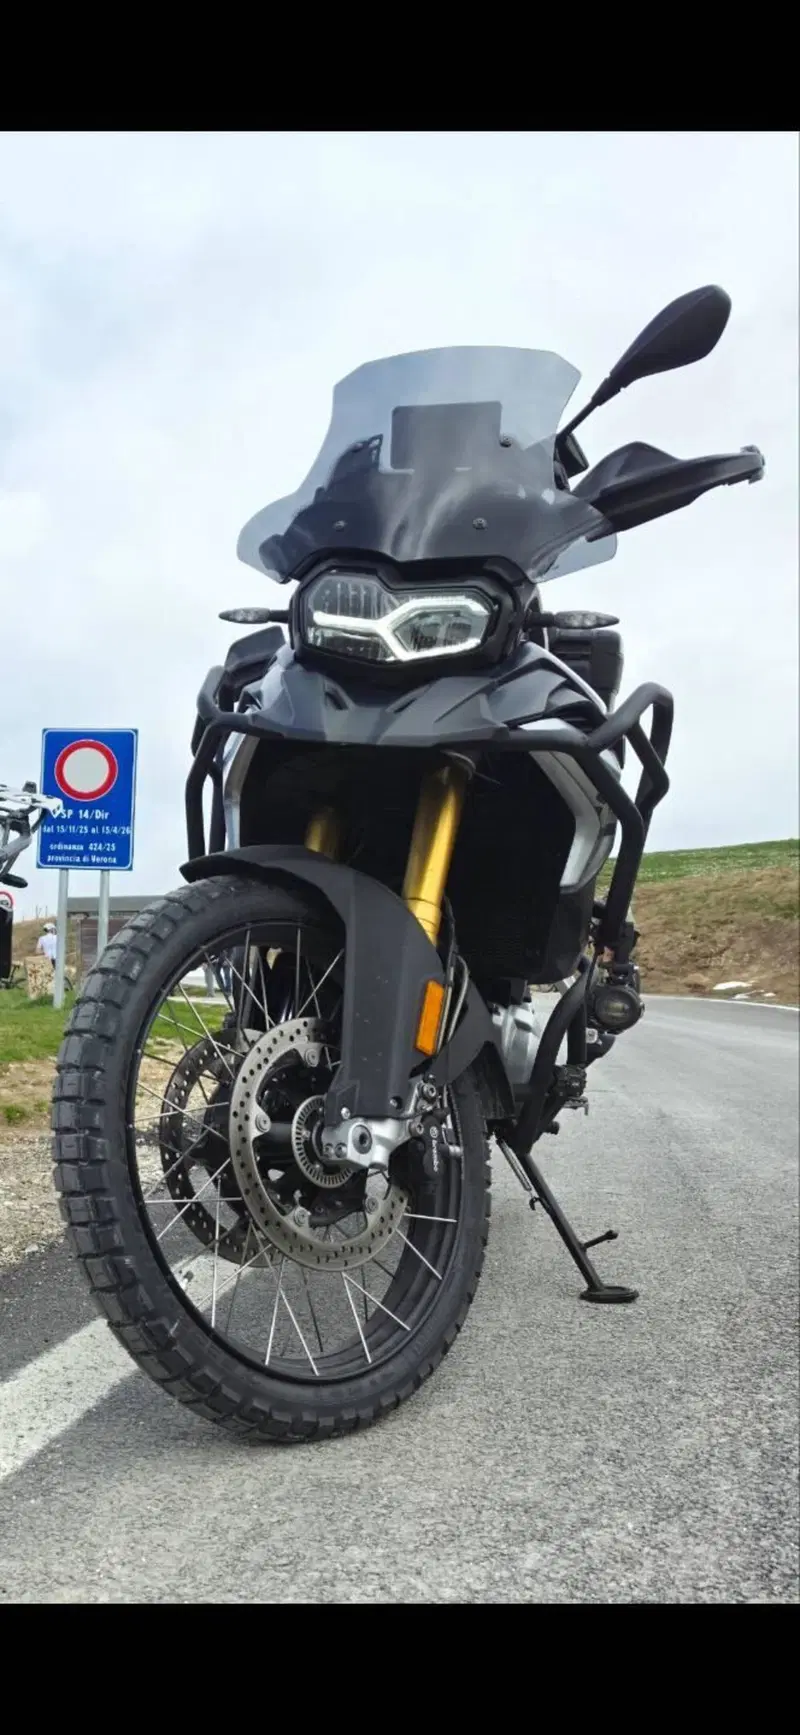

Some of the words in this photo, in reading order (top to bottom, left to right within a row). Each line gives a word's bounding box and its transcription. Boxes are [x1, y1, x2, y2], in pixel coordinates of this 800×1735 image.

[79, 809, 110, 820] 14/Dir
[57, 825, 88, 834] 15/11/25
[91, 826, 99, 834] al
[49, 842, 84, 851] ordinanza
[88, 843, 116, 852] 424/25
[47, 855, 81, 863] provincia
[91, 855, 117, 864] Verona
